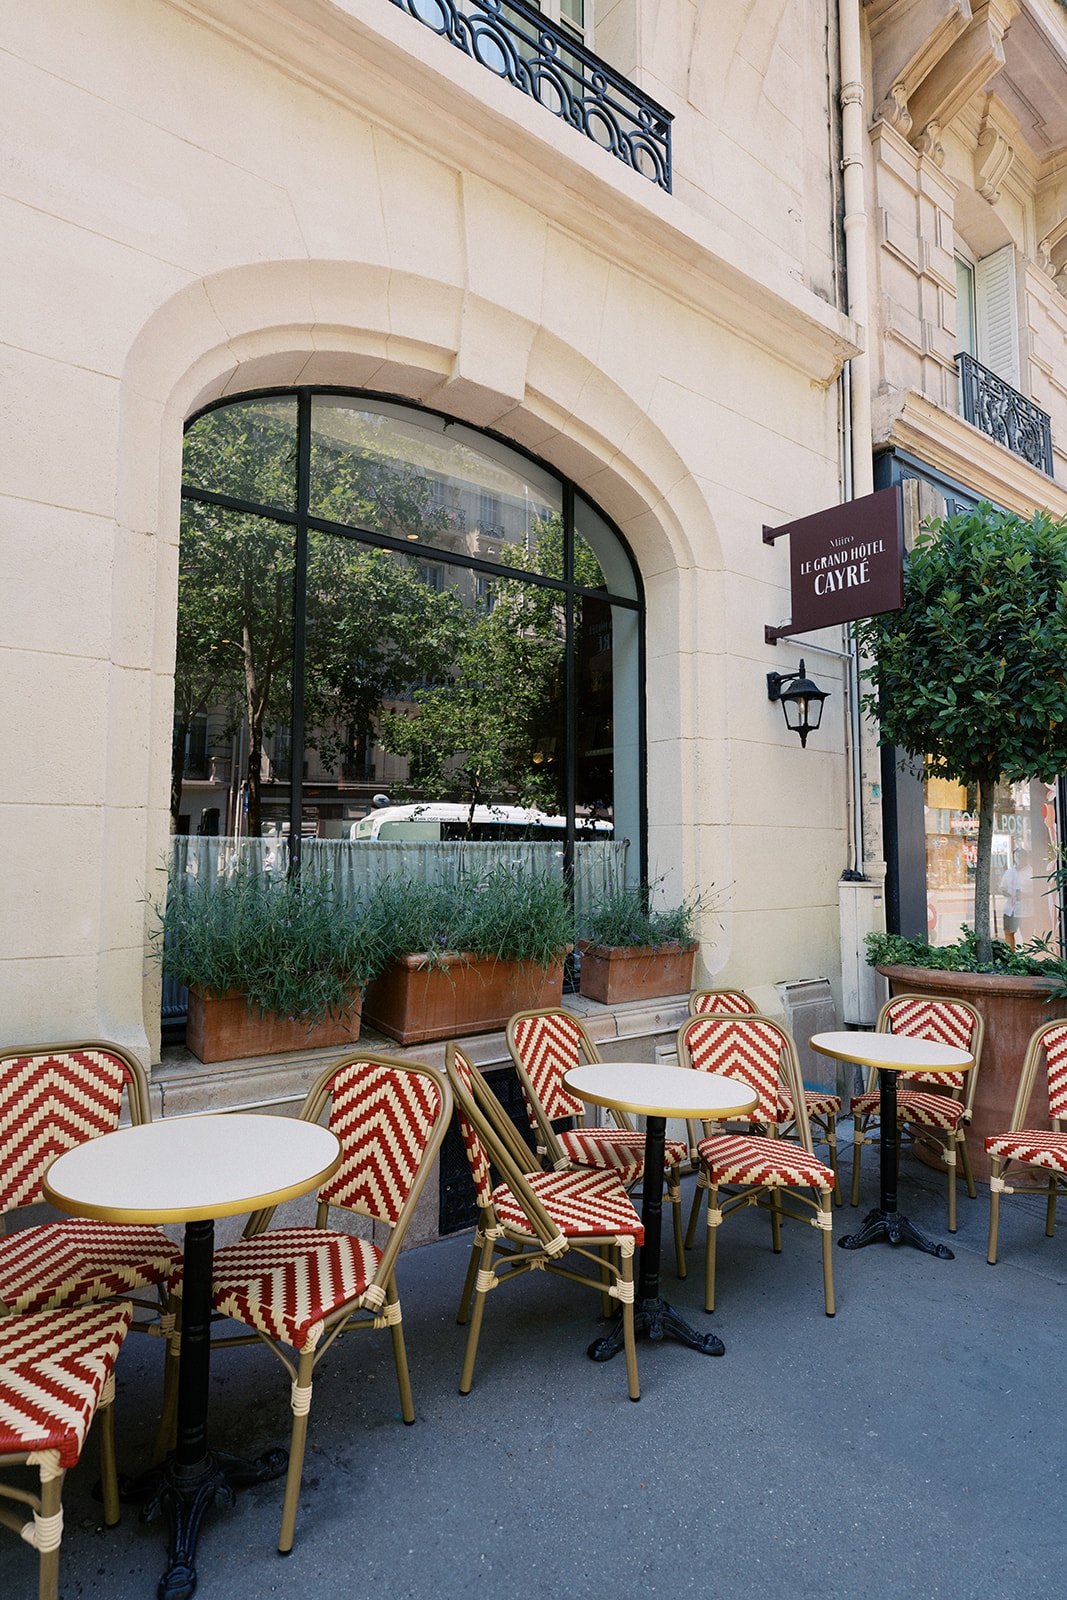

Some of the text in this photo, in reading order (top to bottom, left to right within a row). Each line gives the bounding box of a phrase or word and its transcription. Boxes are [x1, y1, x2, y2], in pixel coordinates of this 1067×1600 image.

[801, 540, 886, 575] LE GRAND HÔTEL
[814, 558, 871, 596] CAYRÉ
